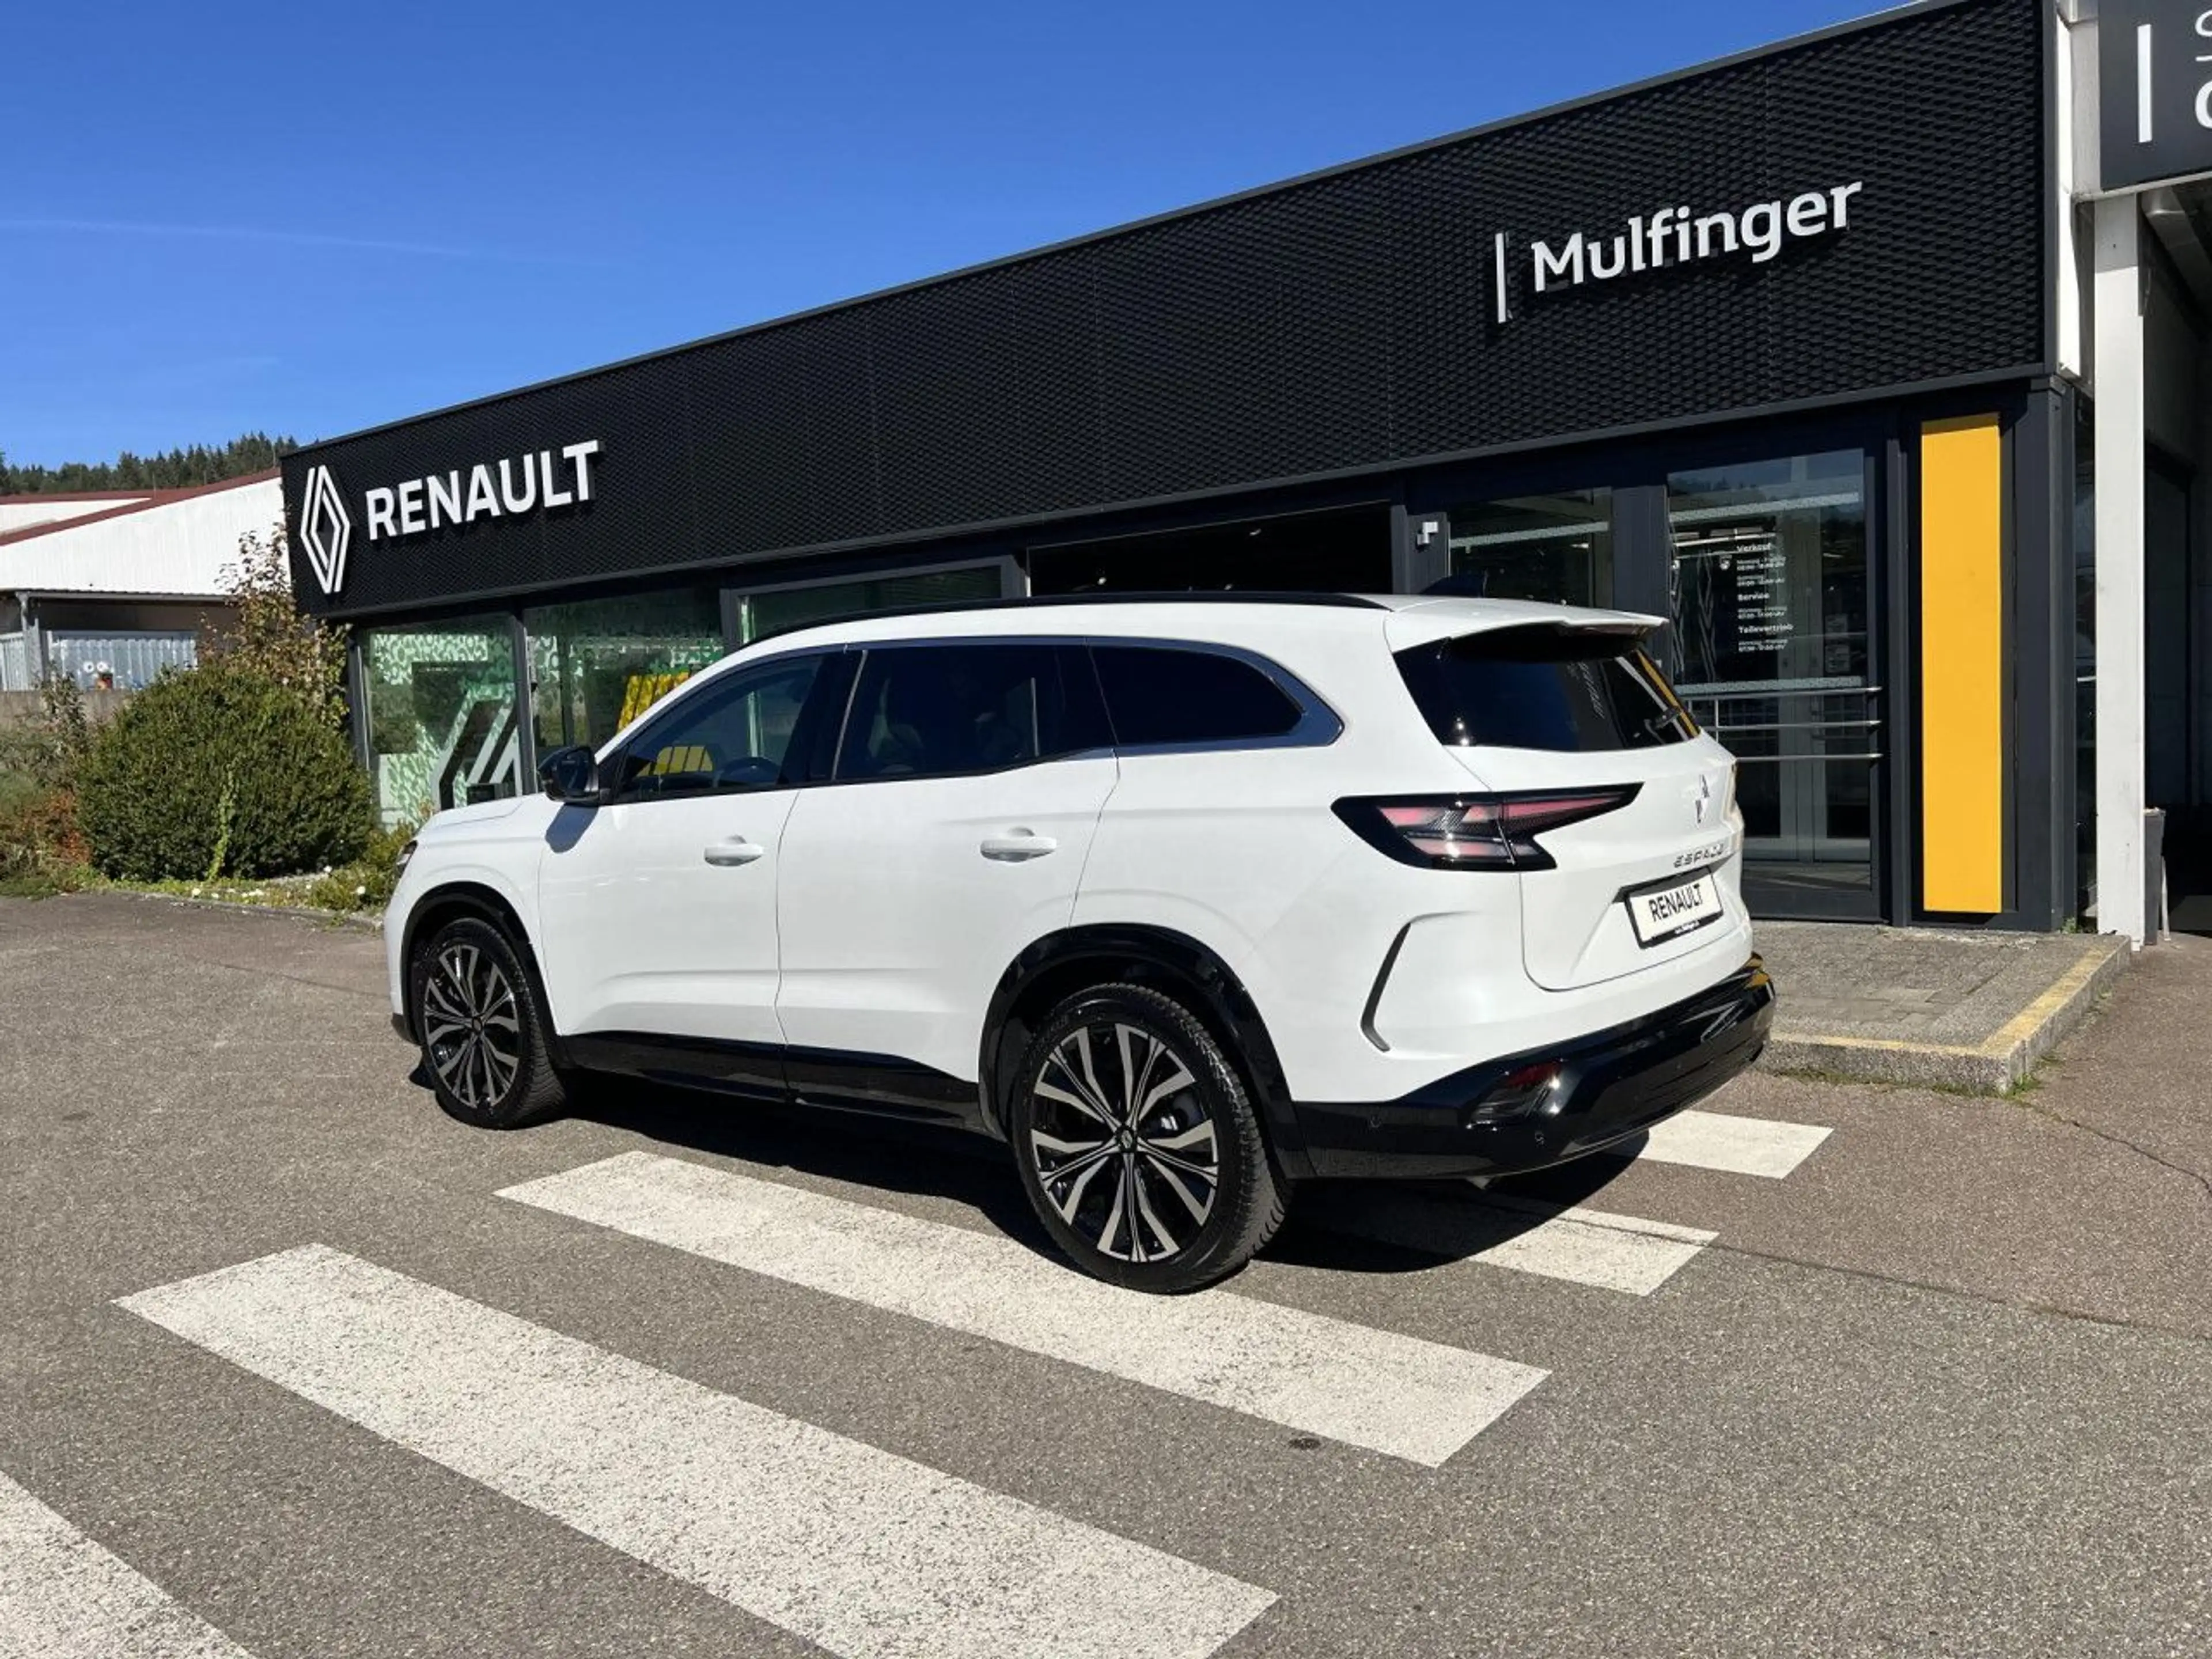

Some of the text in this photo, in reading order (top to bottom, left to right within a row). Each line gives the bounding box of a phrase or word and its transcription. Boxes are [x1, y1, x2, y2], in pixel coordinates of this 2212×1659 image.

[1531, 180, 1862, 292] Mulfinger
[365, 440, 599, 540] RENAULT
[1736, 542, 1772, 552] Verkauf
[1737, 592, 1770, 601] Service
[1649, 882, 1703, 922] RENAULT
